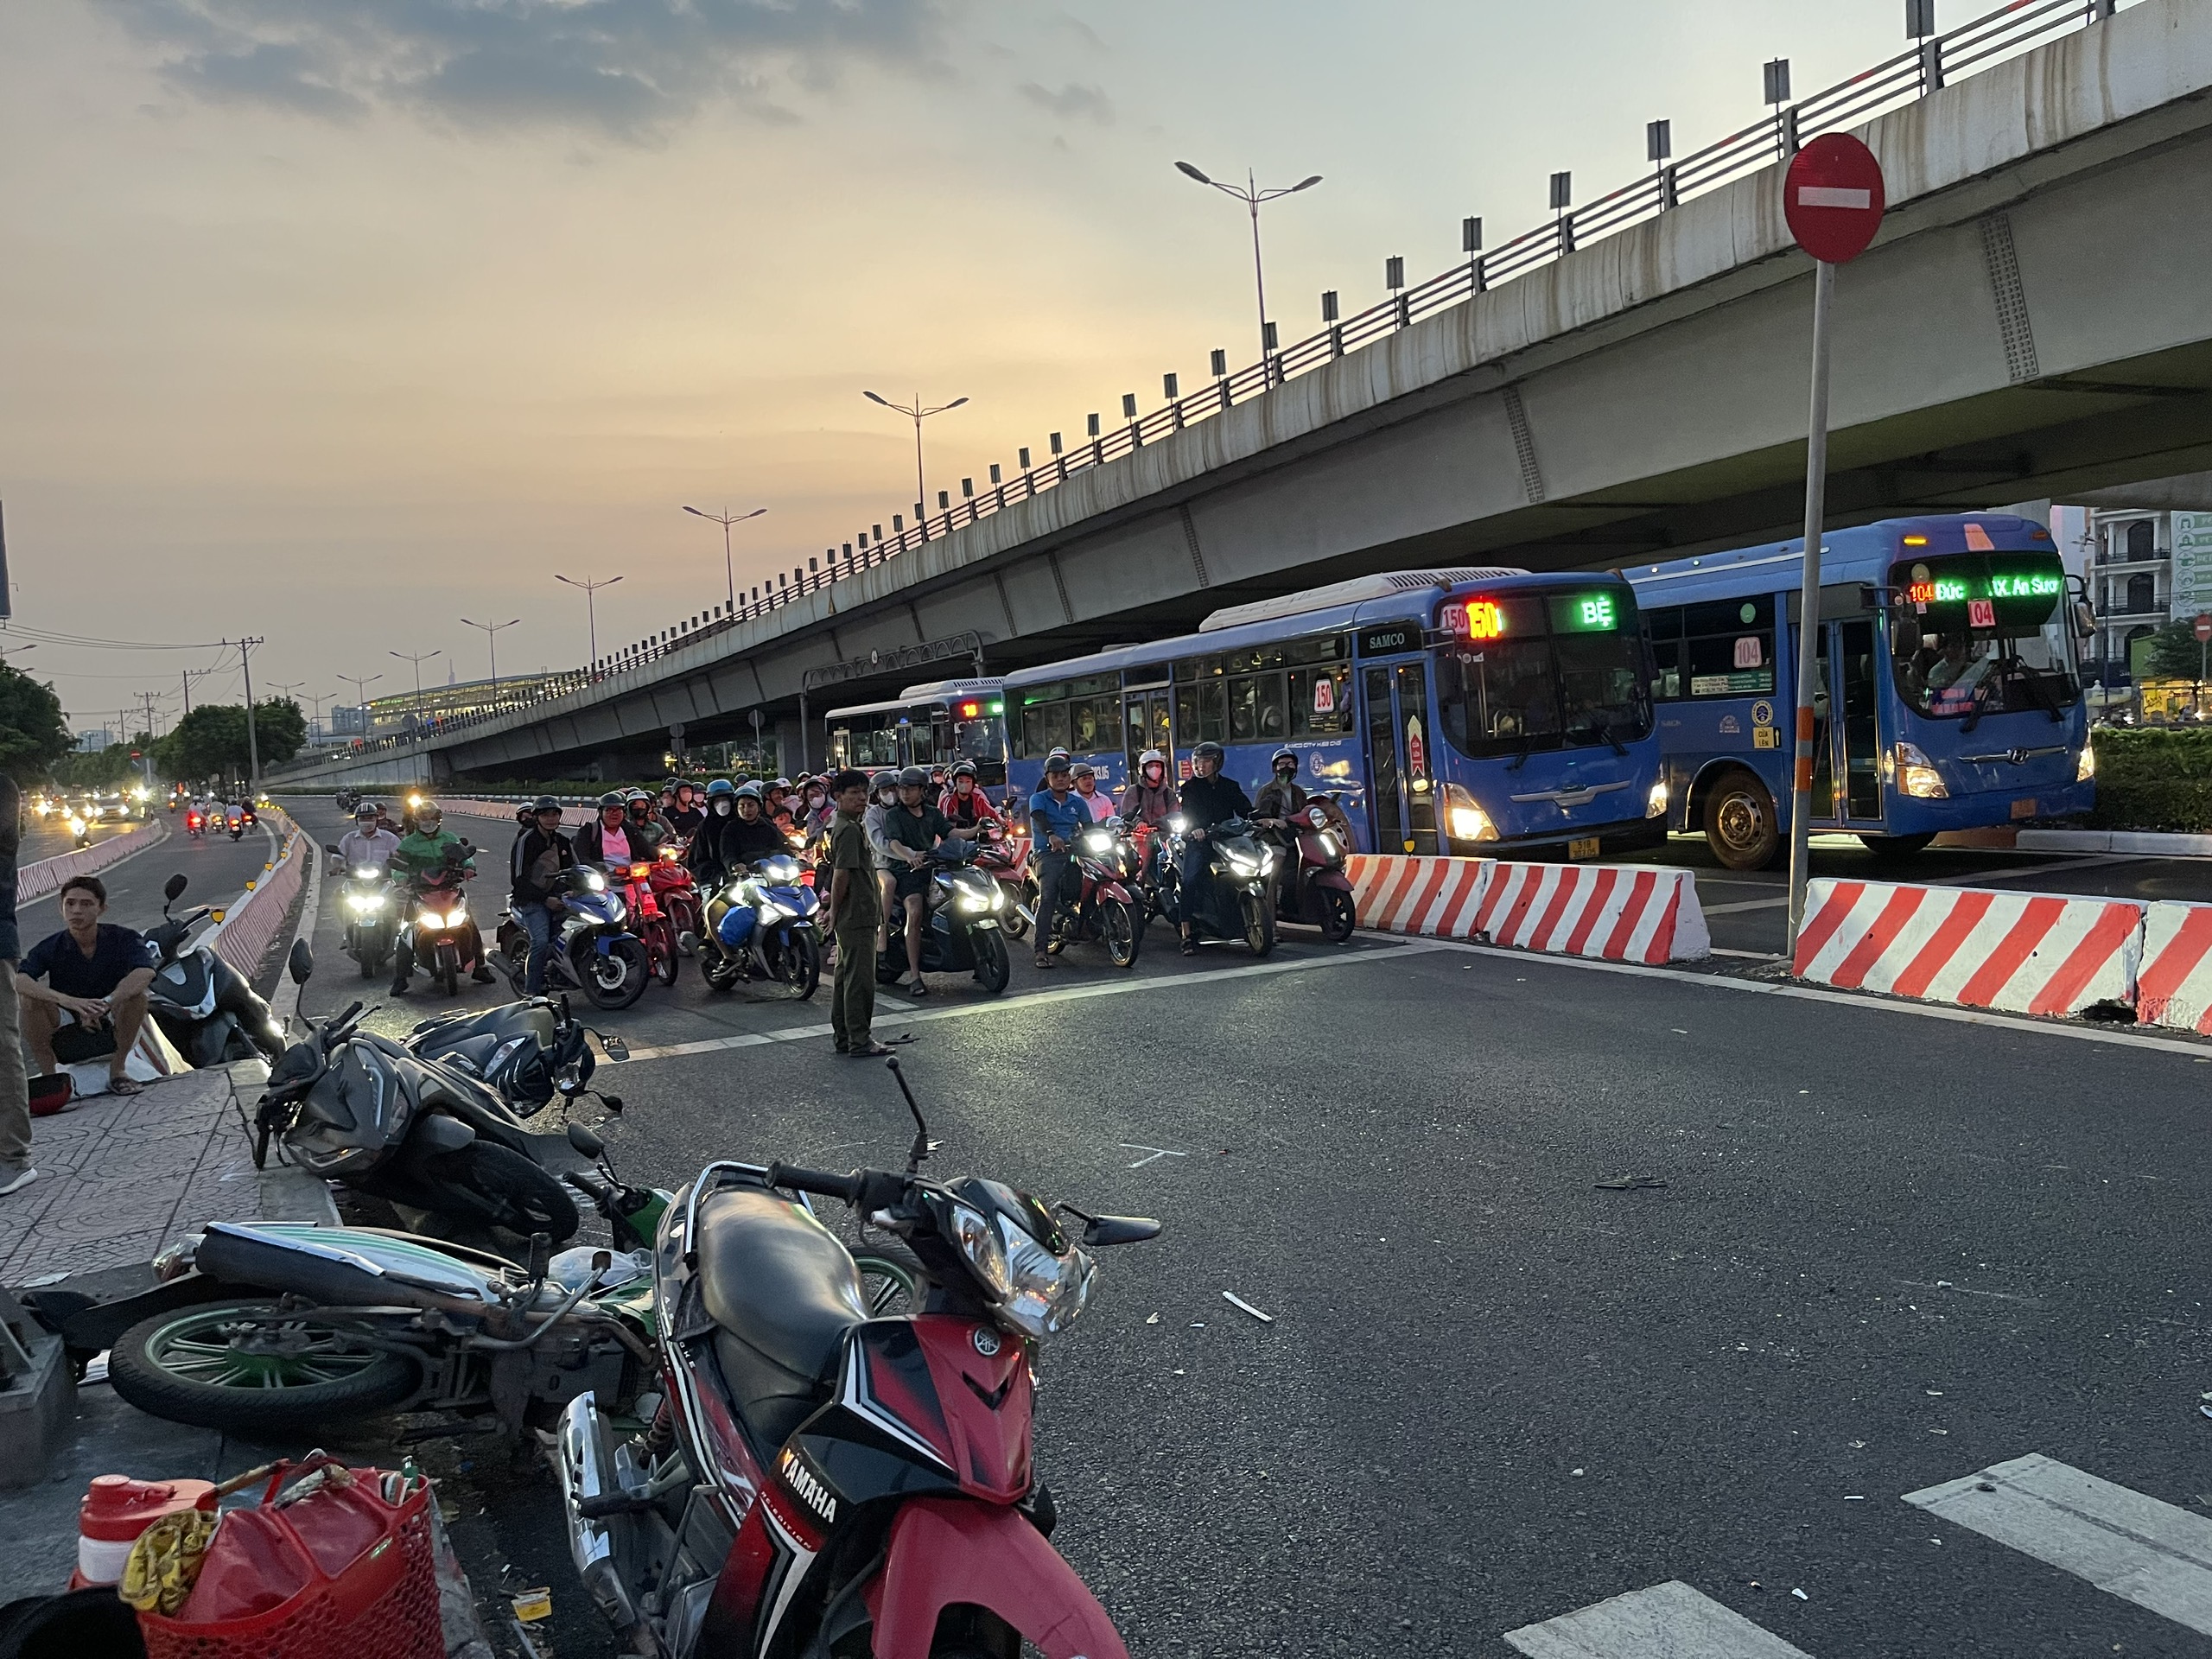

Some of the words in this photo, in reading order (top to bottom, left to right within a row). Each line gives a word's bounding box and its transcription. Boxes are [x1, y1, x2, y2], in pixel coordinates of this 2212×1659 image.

[1910, 583, 1934, 602] 104
[2012, 578, 2030, 595] An
[1444, 608, 1465, 628] 150
[1466, 602, 1497, 638] 150
[1969, 603, 1992, 624] 104
[1370, 632, 1405, 649] SAMCO
[1737, 641, 1759, 664] 104
[1316, 684, 1332, 709] 150
[782, 1447, 837, 1523] YAMAHA
